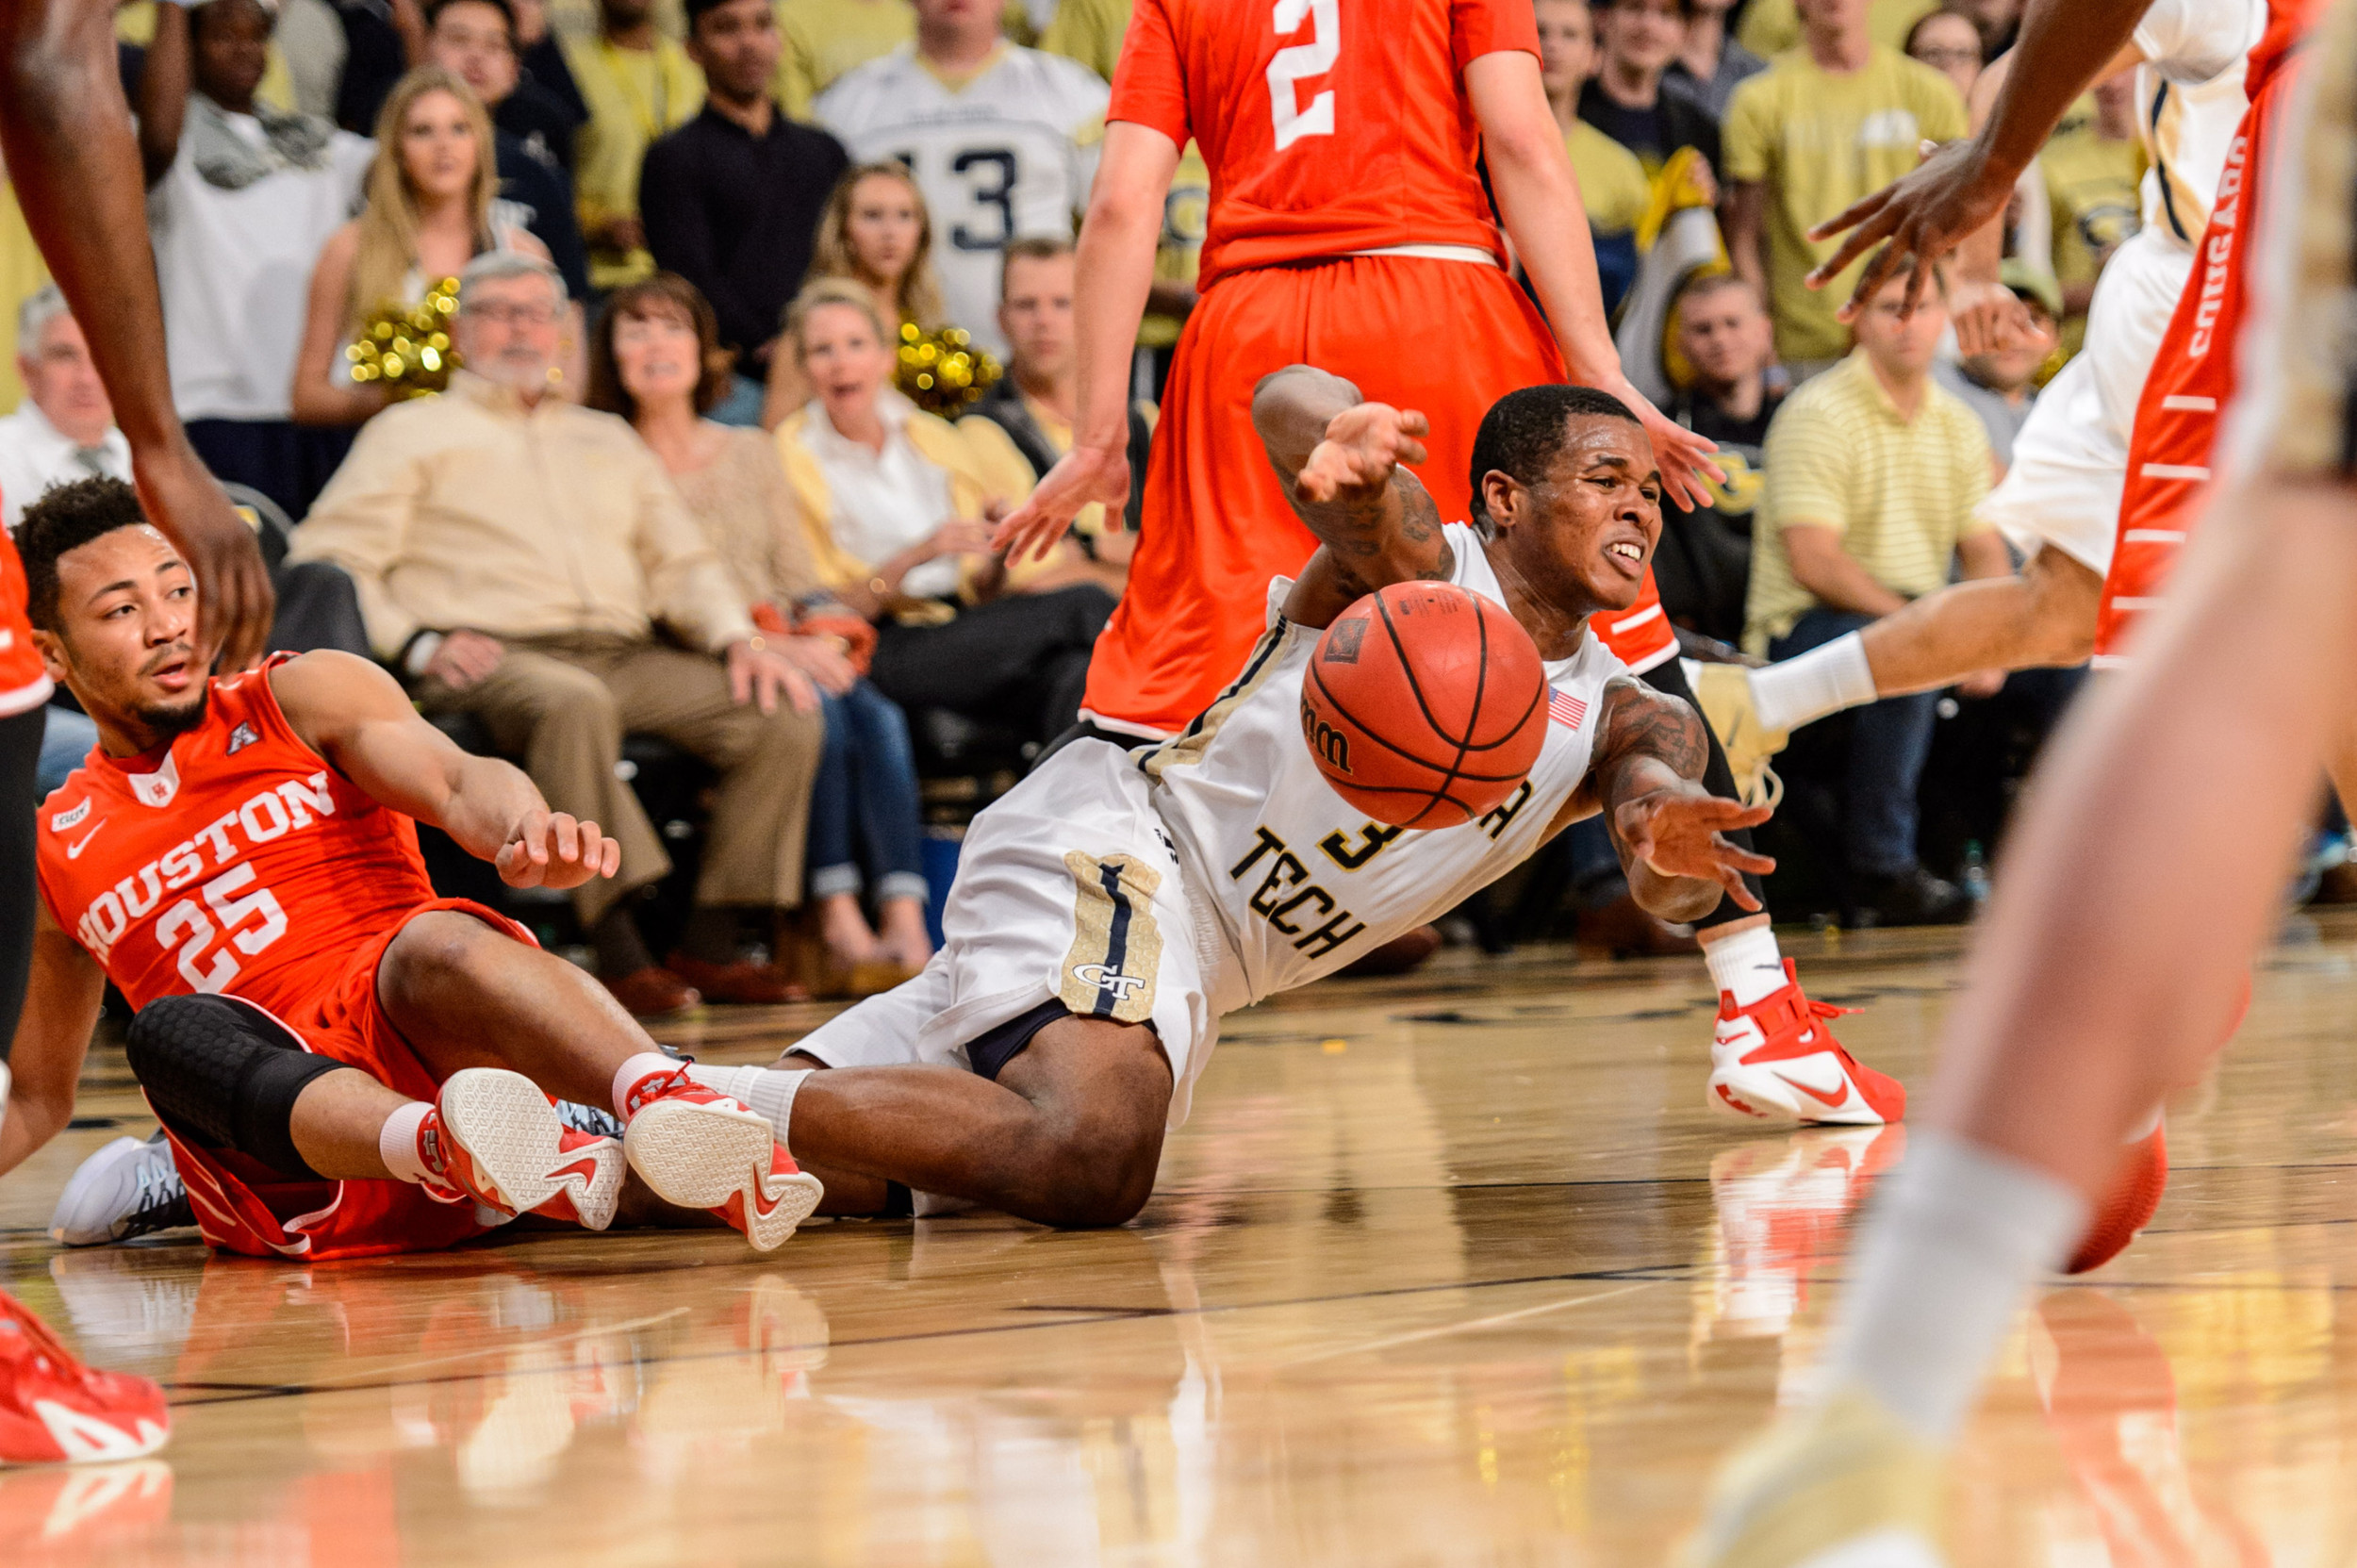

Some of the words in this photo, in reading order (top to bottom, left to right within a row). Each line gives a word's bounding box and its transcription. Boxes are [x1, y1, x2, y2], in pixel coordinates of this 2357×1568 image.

[1265, 0, 1341, 152] 2
[76, 769, 337, 967] HOUSTON
[155, 861, 288, 995] 25
[1229, 825, 1367, 960] TECH
[1072, 963, 1146, 1000] GT
